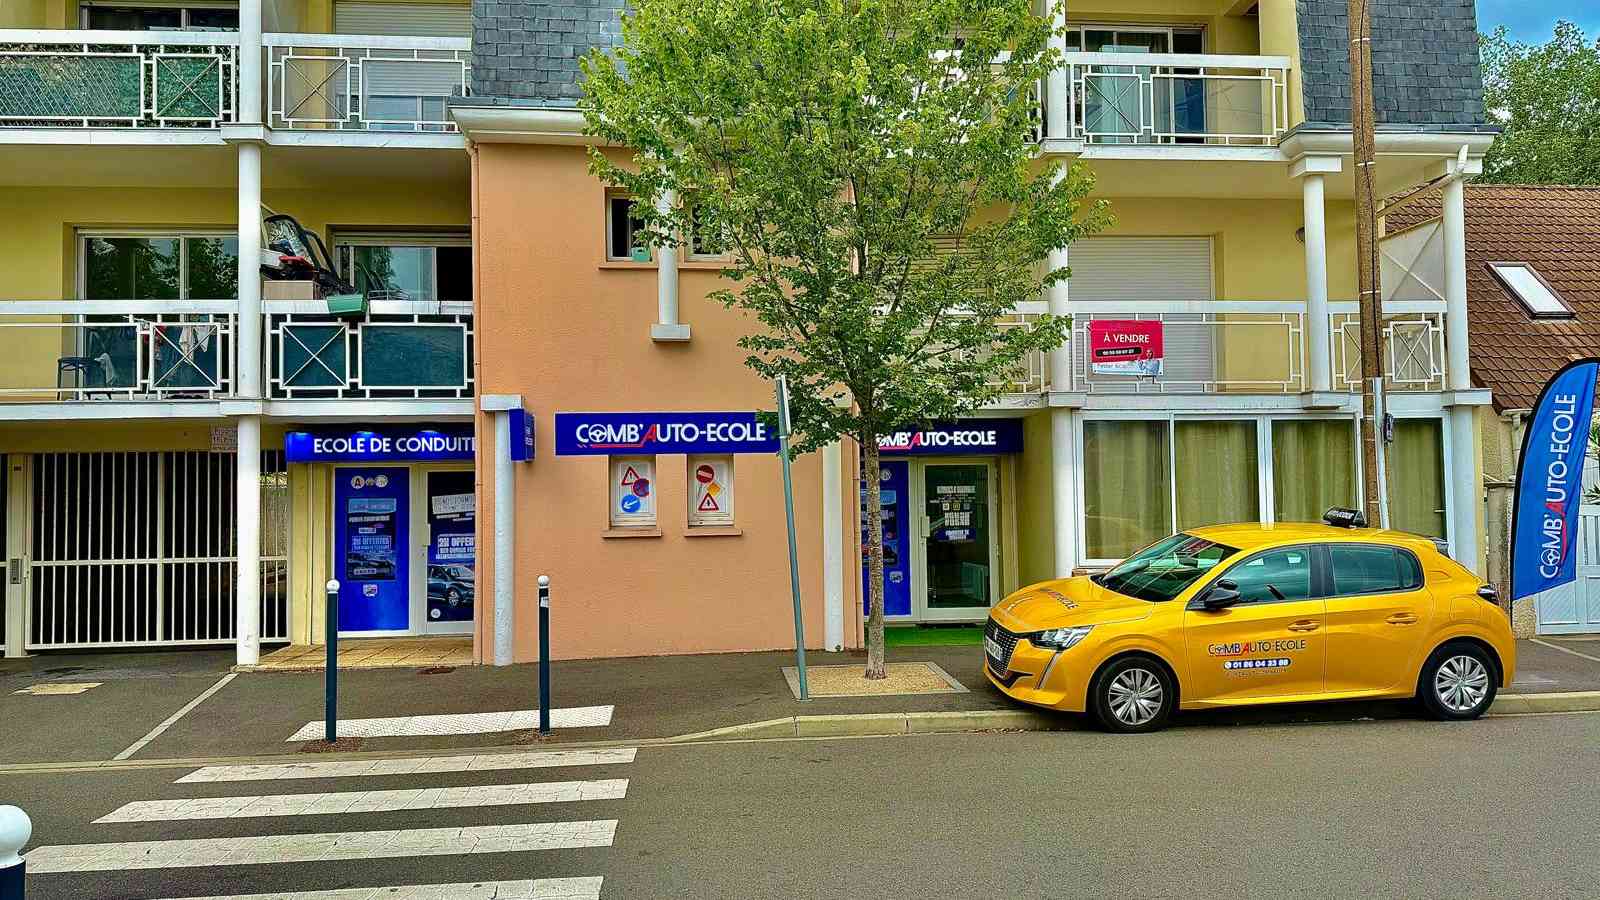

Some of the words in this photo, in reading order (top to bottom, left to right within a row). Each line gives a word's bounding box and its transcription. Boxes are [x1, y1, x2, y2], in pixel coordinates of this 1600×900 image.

[1103, 331, 1111, 343] À
[1113, 334, 1150, 344] VENDRE
[575, 422, 767, 443] COMB'AUTO-ECOLE
[313, 438, 366, 453] ECOLE
[370, 438, 391, 453] DE
[1539, 394, 1577, 579] COMB'AUTO-ECOLE
[1232, 661, 1242, 669] 01
